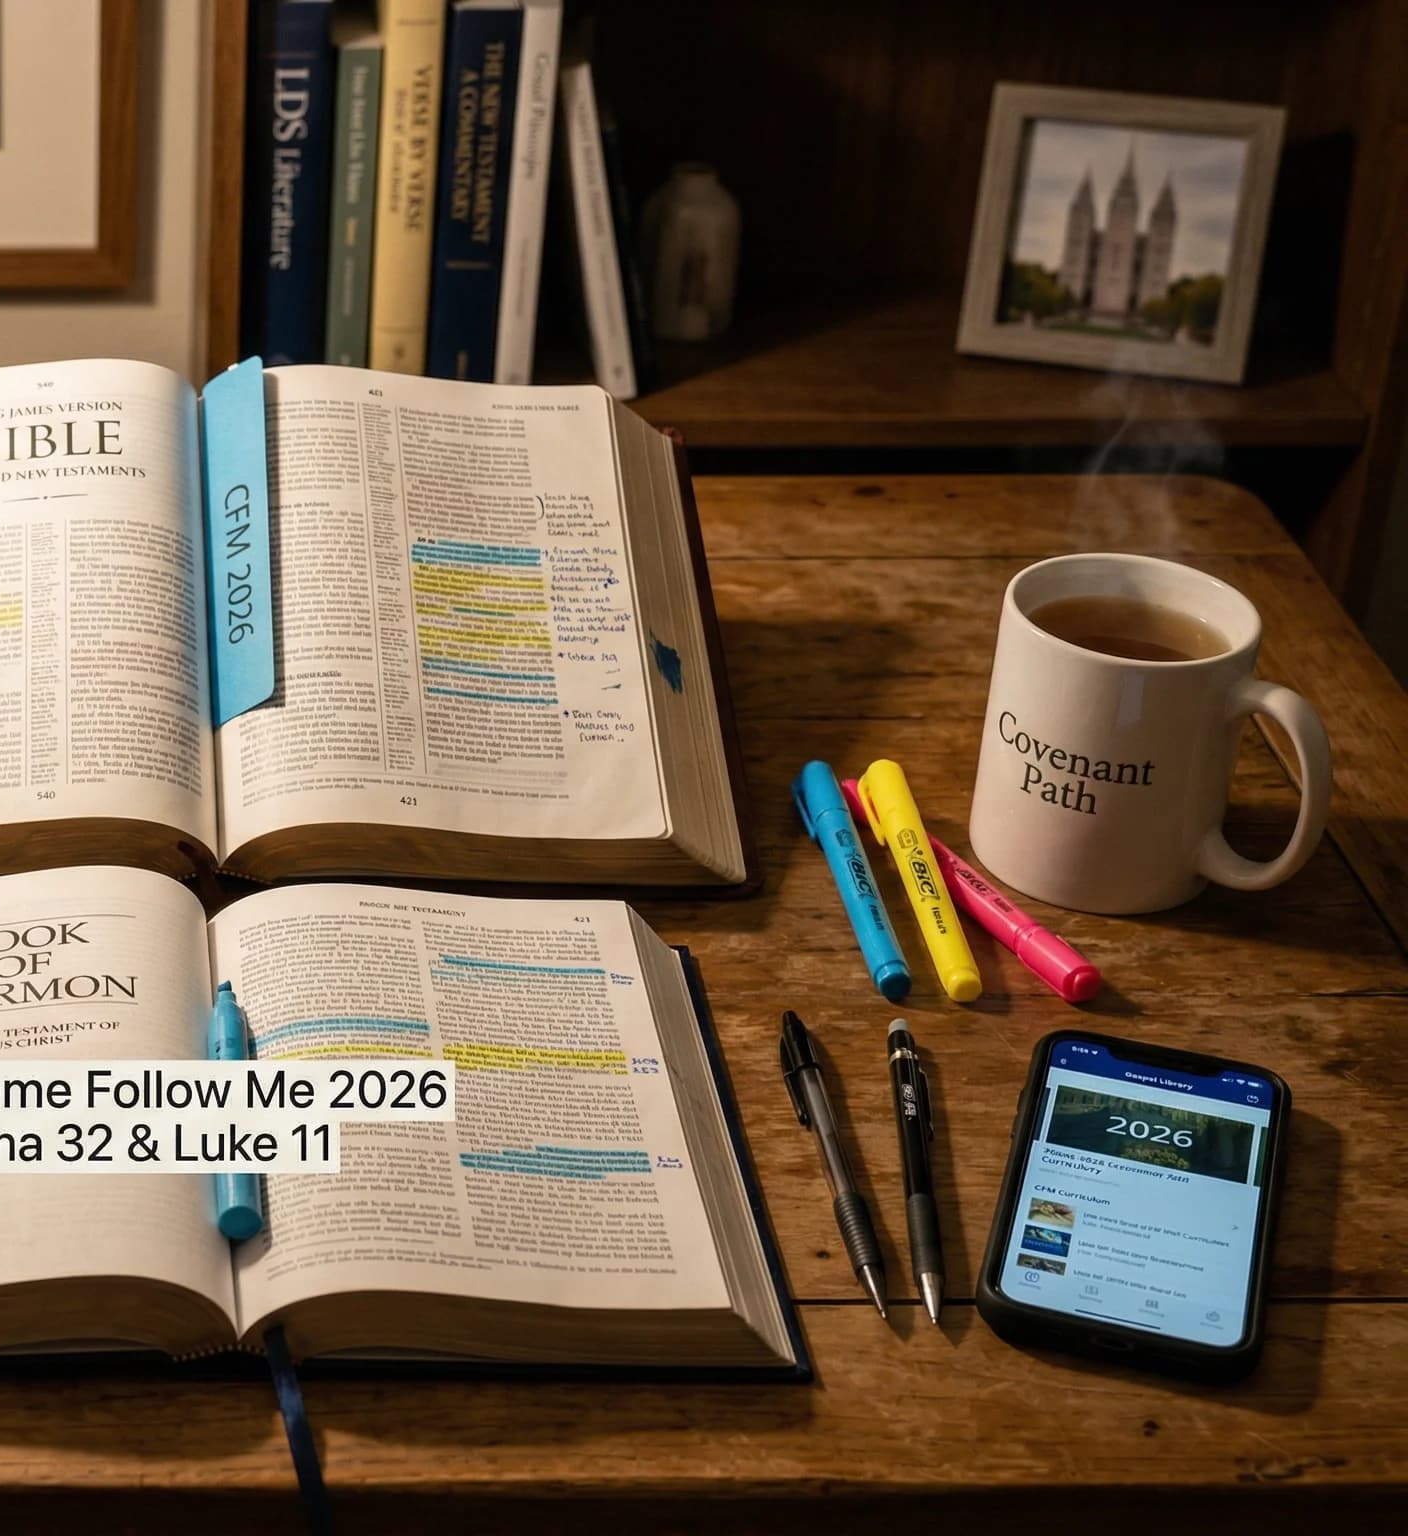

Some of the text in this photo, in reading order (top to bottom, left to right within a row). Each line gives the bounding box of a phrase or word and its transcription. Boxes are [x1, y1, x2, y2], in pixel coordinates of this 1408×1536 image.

[272, 67, 310, 142] LDS
[8, 403, 54, 420] JAMES
[58, 401, 123, 413] VERSION
[15, 467, 49, 481] NEW
[54, 464, 147, 479] TESTAMENTS
[225, 484, 254, 645] CFM 2026
[999, 711, 1156, 787] Covenant
[399, 796, 417, 806] 421
[1020, 761, 1098, 816] Path
[849, 858, 875, 898] BIC
[910, 858, 936, 899] BIC
[2, 1021, 96, 1039] TESTAMENT
[99, 1020, 122, 1032] OF
[16, 1033, 75, 1050] CHRIST
[1105, 1115, 1194, 1148] 2026
